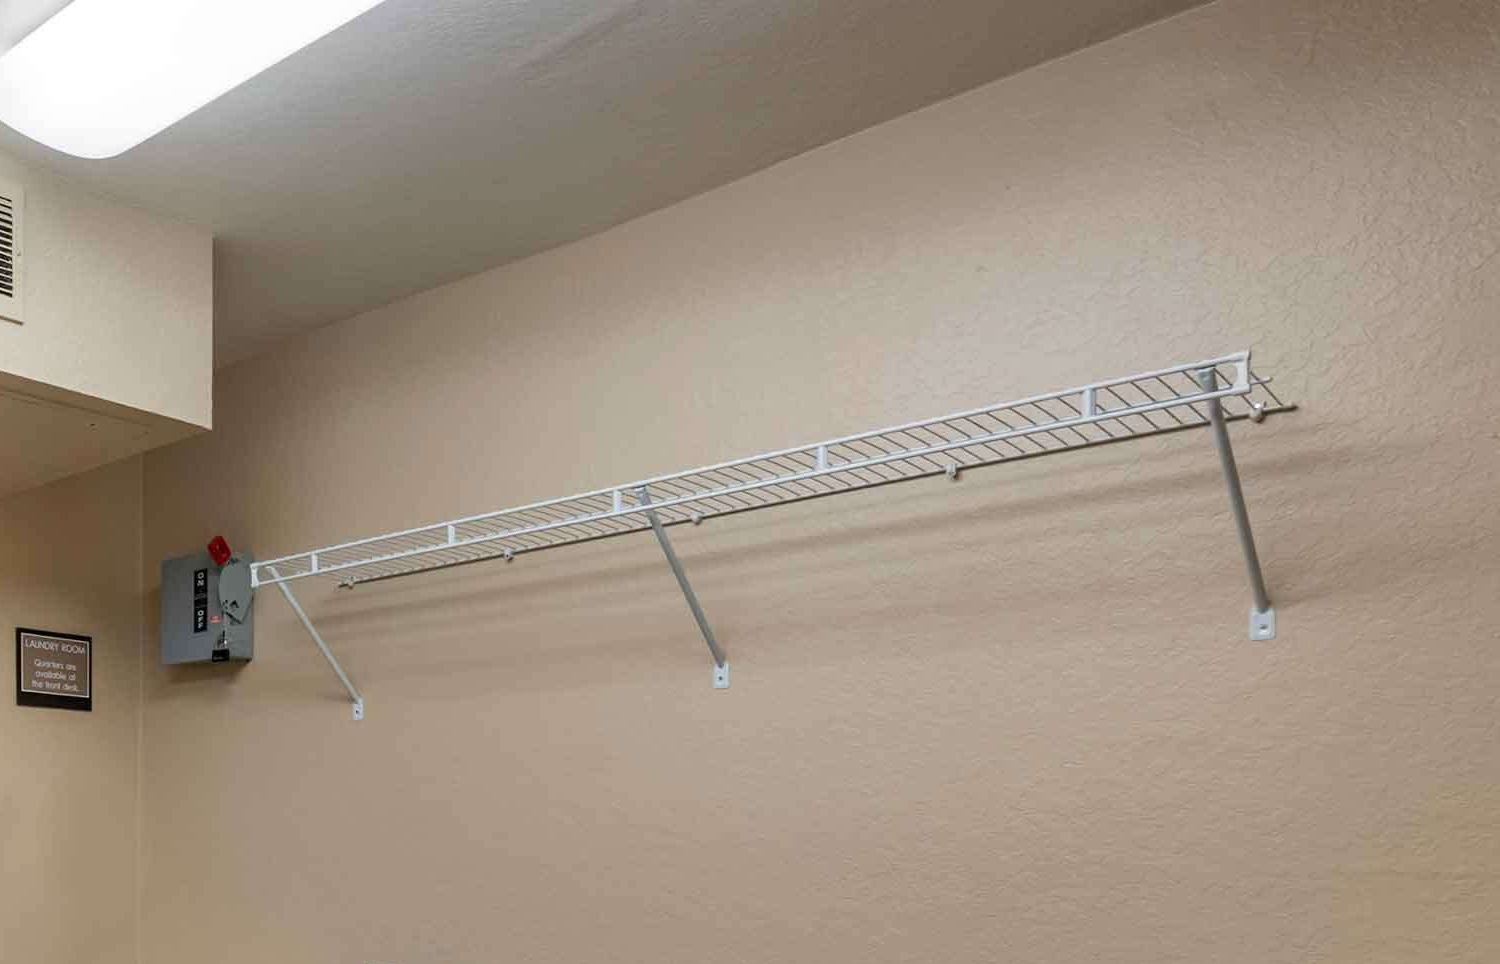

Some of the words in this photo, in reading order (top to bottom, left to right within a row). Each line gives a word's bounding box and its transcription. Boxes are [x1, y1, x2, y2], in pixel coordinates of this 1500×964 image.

[24, 639, 59, 653] LAUNDRY
[60, 643, 85, 655] ROOM
[33, 659, 64, 671] Quarters
[65, 664, 77, 672] are
[35, 671, 67, 680] available
[68, 671, 77, 681] at
[31, 680, 43, 689] the
[45, 681, 61, 690] front
